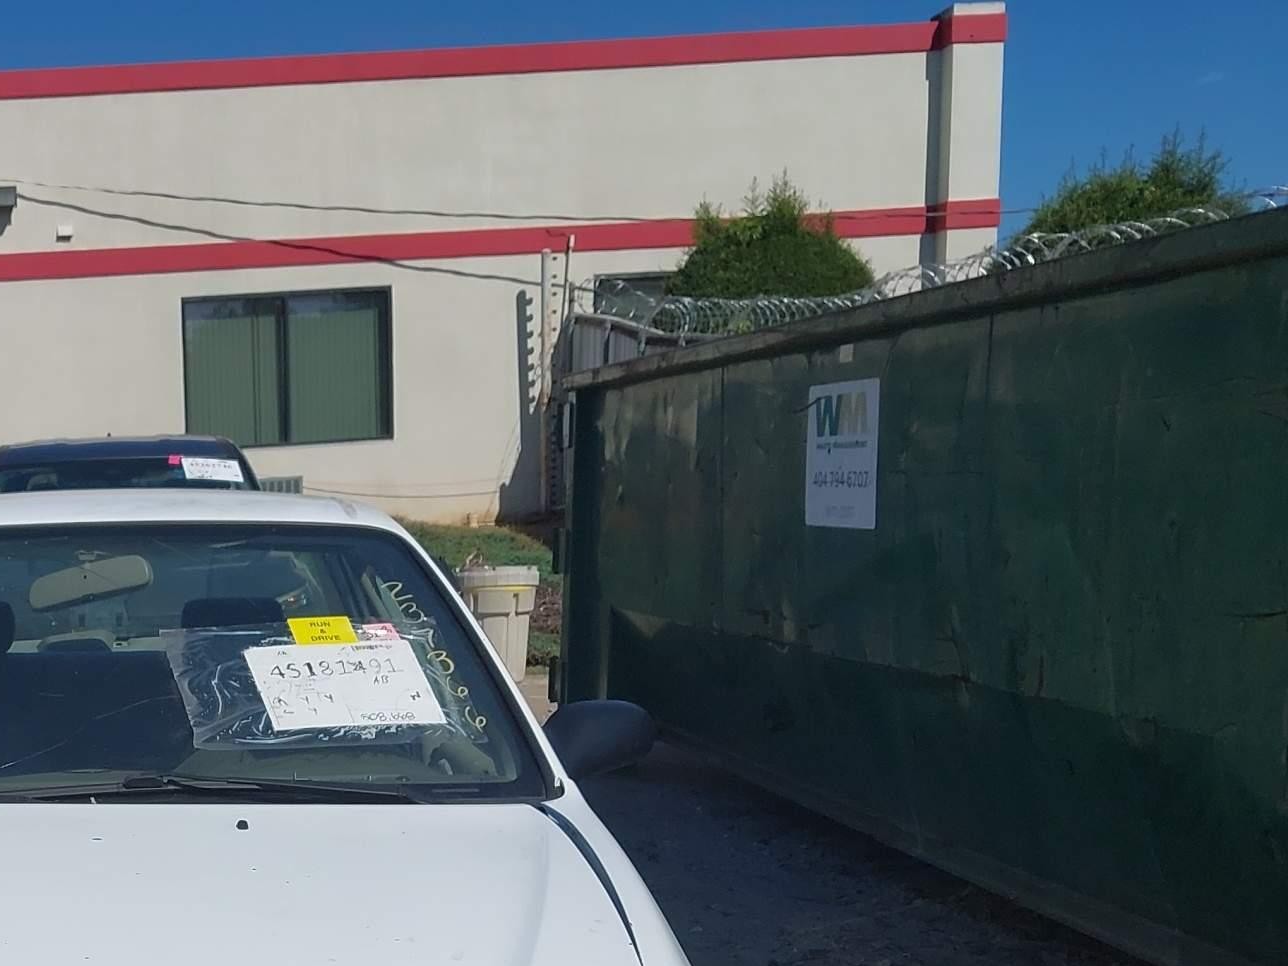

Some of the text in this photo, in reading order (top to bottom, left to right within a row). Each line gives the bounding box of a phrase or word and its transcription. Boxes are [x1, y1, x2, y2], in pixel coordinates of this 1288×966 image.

[815, 392, 867, 437] WM
[846, 470, 870, 488] 6707
[309, 620, 330, 628] RUN
[310, 634, 342, 642] DRIVE
